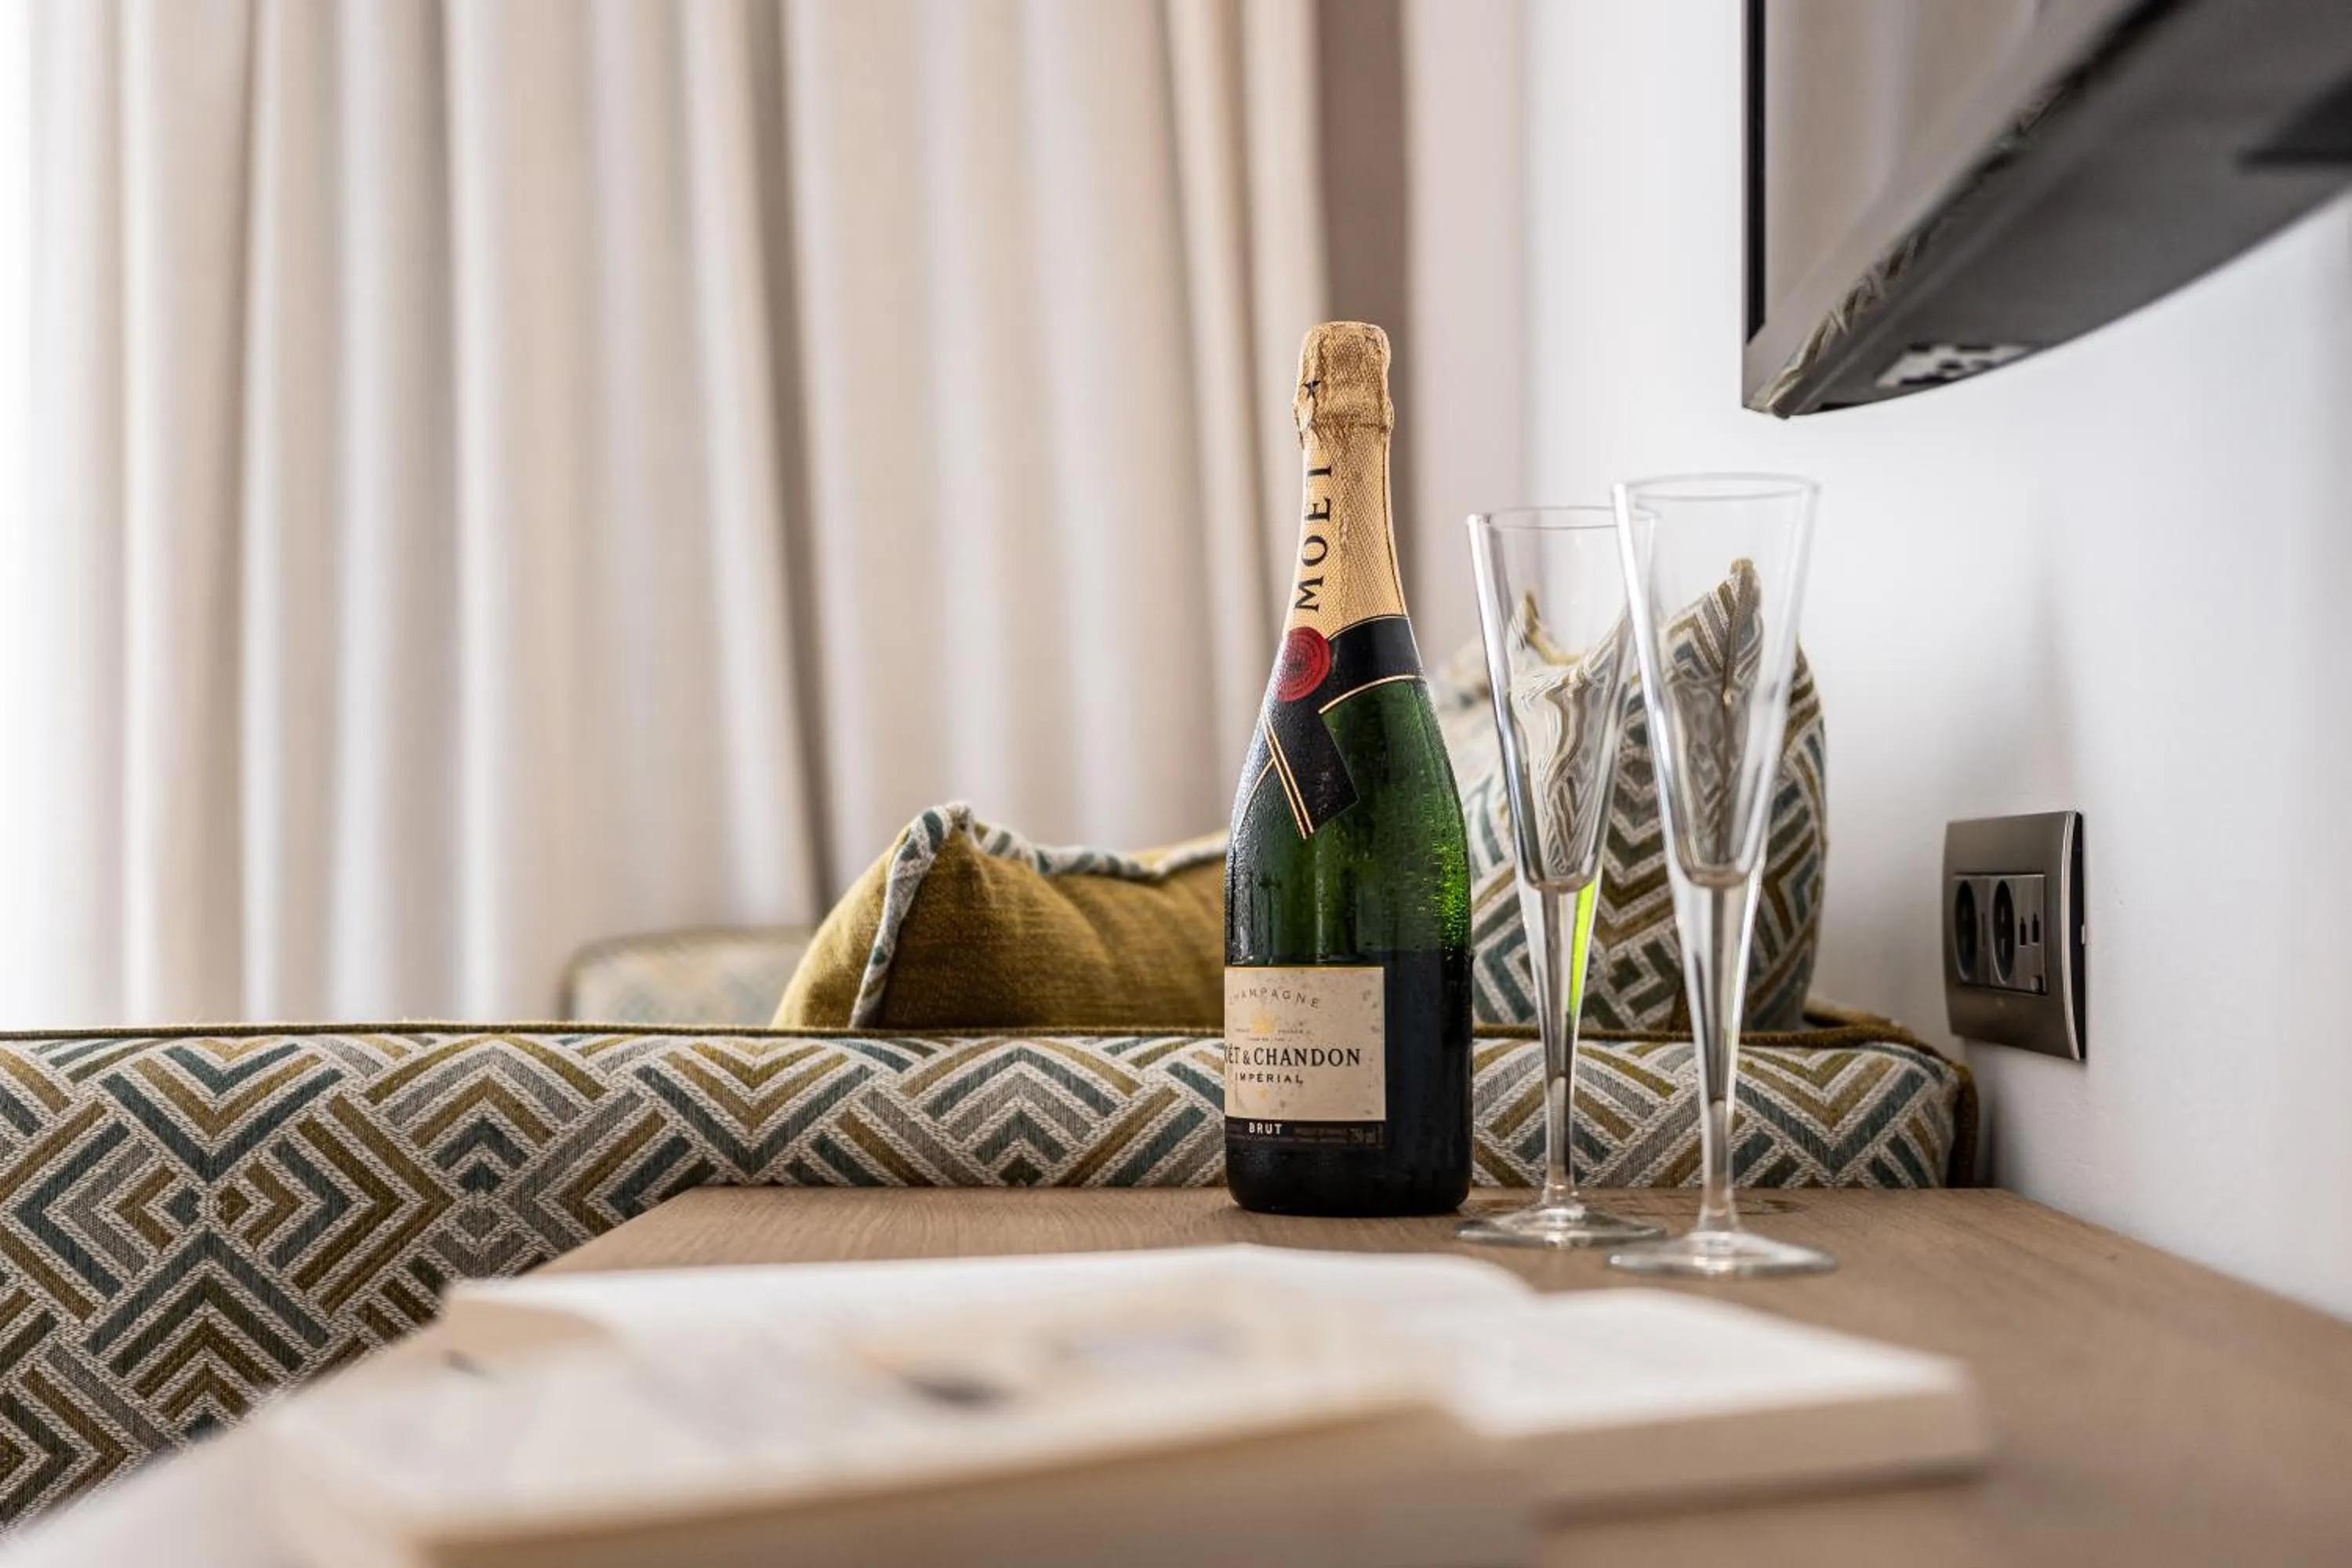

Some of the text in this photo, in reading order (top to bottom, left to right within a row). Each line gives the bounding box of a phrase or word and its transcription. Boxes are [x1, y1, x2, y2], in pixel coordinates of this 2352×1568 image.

[1243, 1050, 1252, 1065] &
[1254, 1047, 1361, 1067] CHANDON
[1248, 1122, 1283, 1134] BRUT
